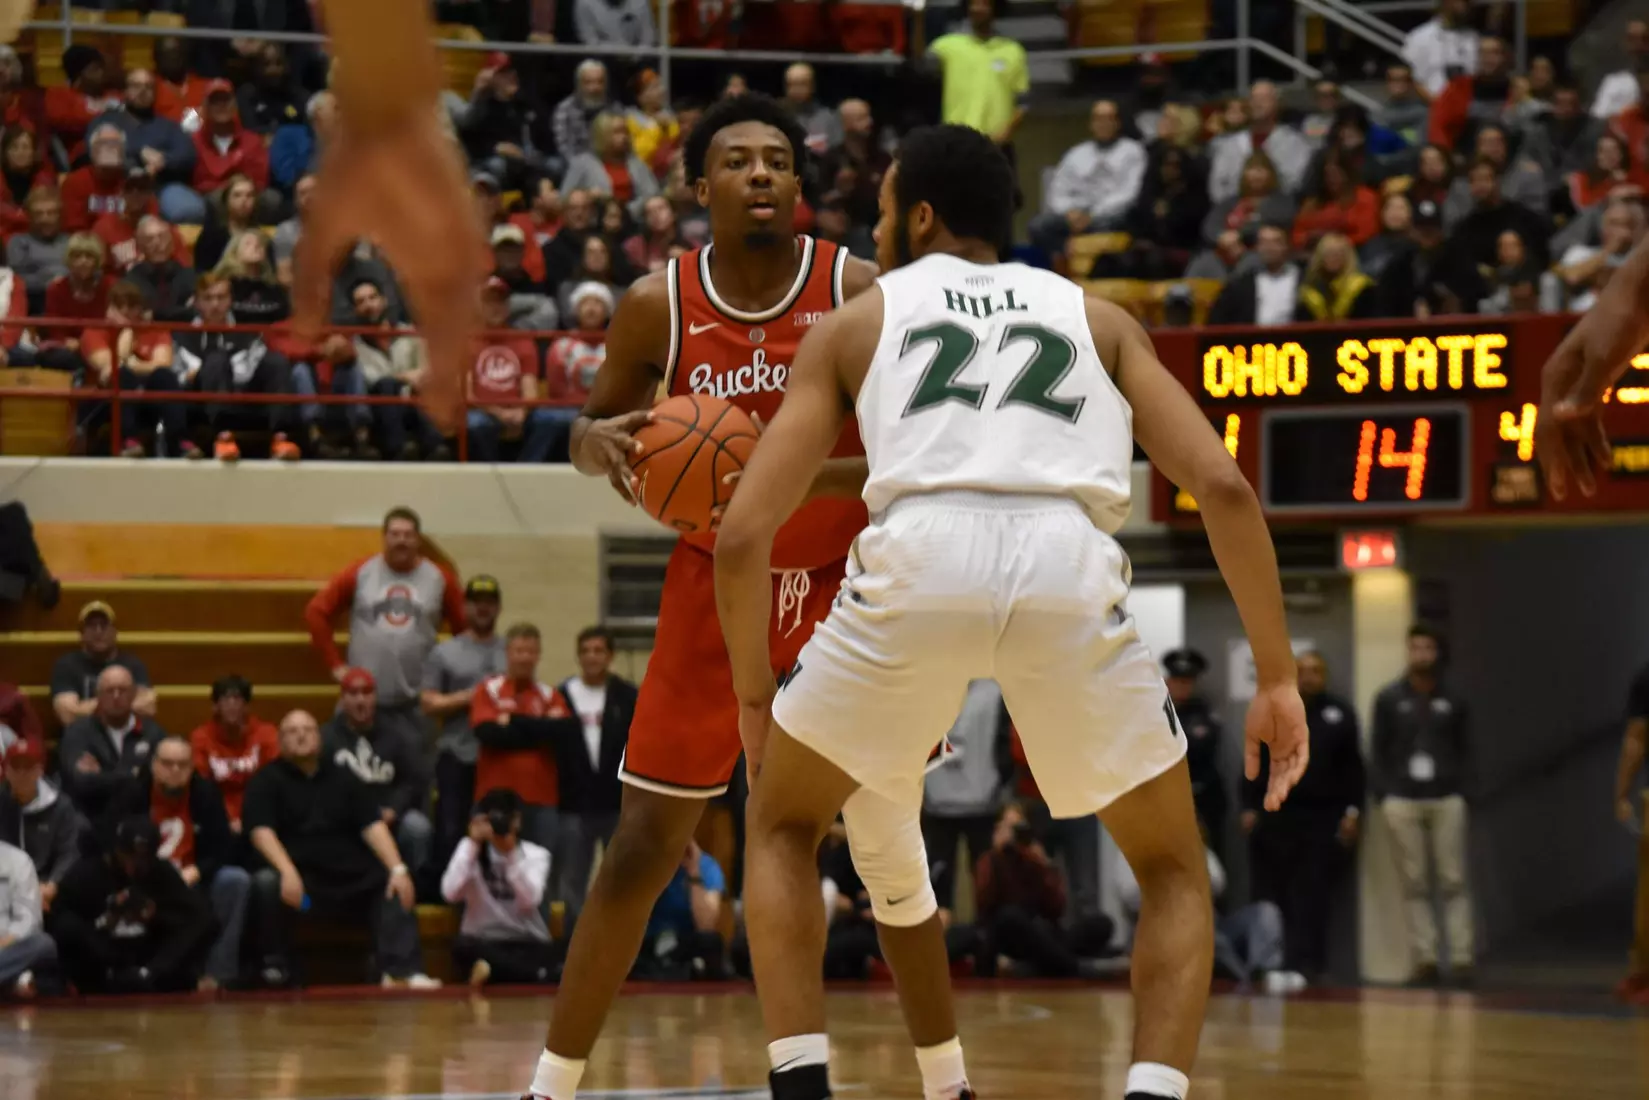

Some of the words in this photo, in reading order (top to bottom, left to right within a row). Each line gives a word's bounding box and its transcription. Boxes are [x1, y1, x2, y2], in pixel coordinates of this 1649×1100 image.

[943, 286, 1029, 319] HILL
[688, 348, 793, 400] Bucke
[898, 320, 1087, 425] 22
[1203, 342, 1308, 398] OHIO
[1336, 333, 1507, 394] STATE
[1352, 417, 1431, 500] 14
[1499, 402, 1538, 462] 4
